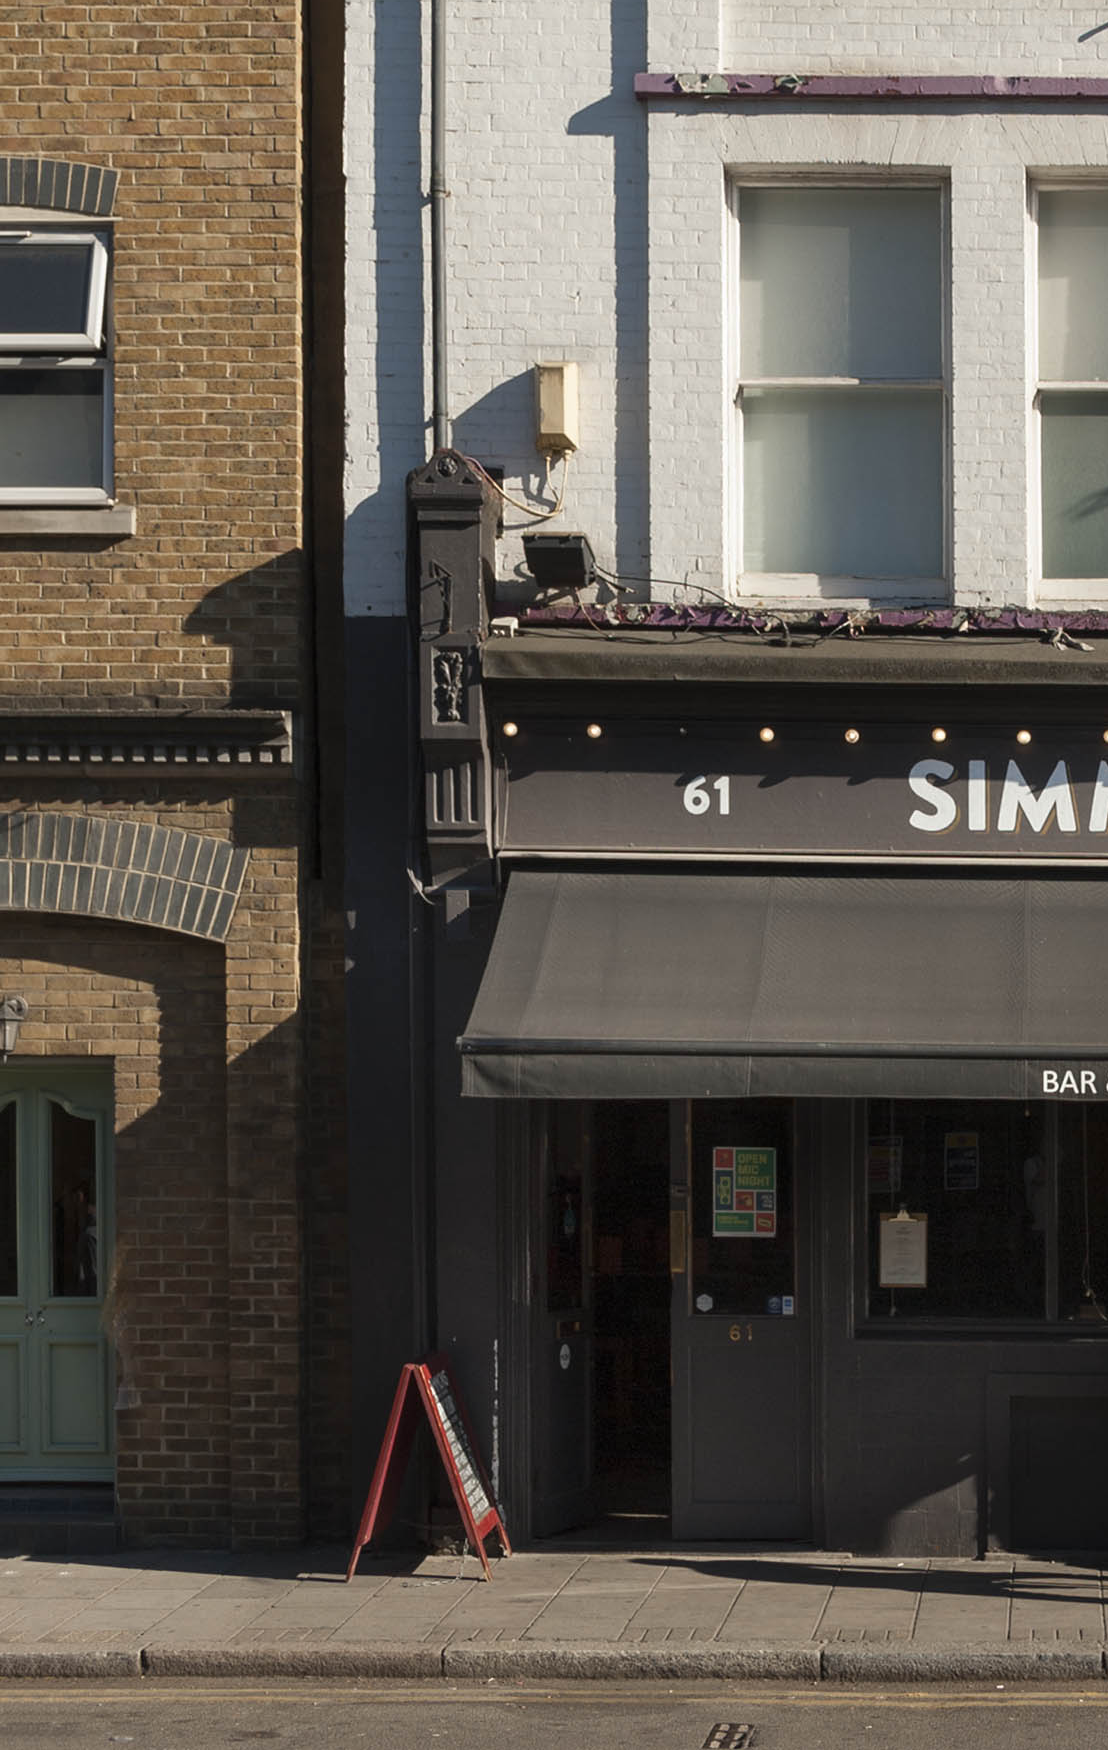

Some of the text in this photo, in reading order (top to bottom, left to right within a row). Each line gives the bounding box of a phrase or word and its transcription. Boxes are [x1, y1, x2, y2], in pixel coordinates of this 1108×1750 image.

[683, 776, 730, 816] 61
[1043, 1070, 1097, 1096] BAR
[738, 1153, 768, 1165] OPEN
[738, 1164, 759, 1176] MIC
[738, 1176, 771, 1187] NIGHT
[729, 1323, 753, 1342] 61
